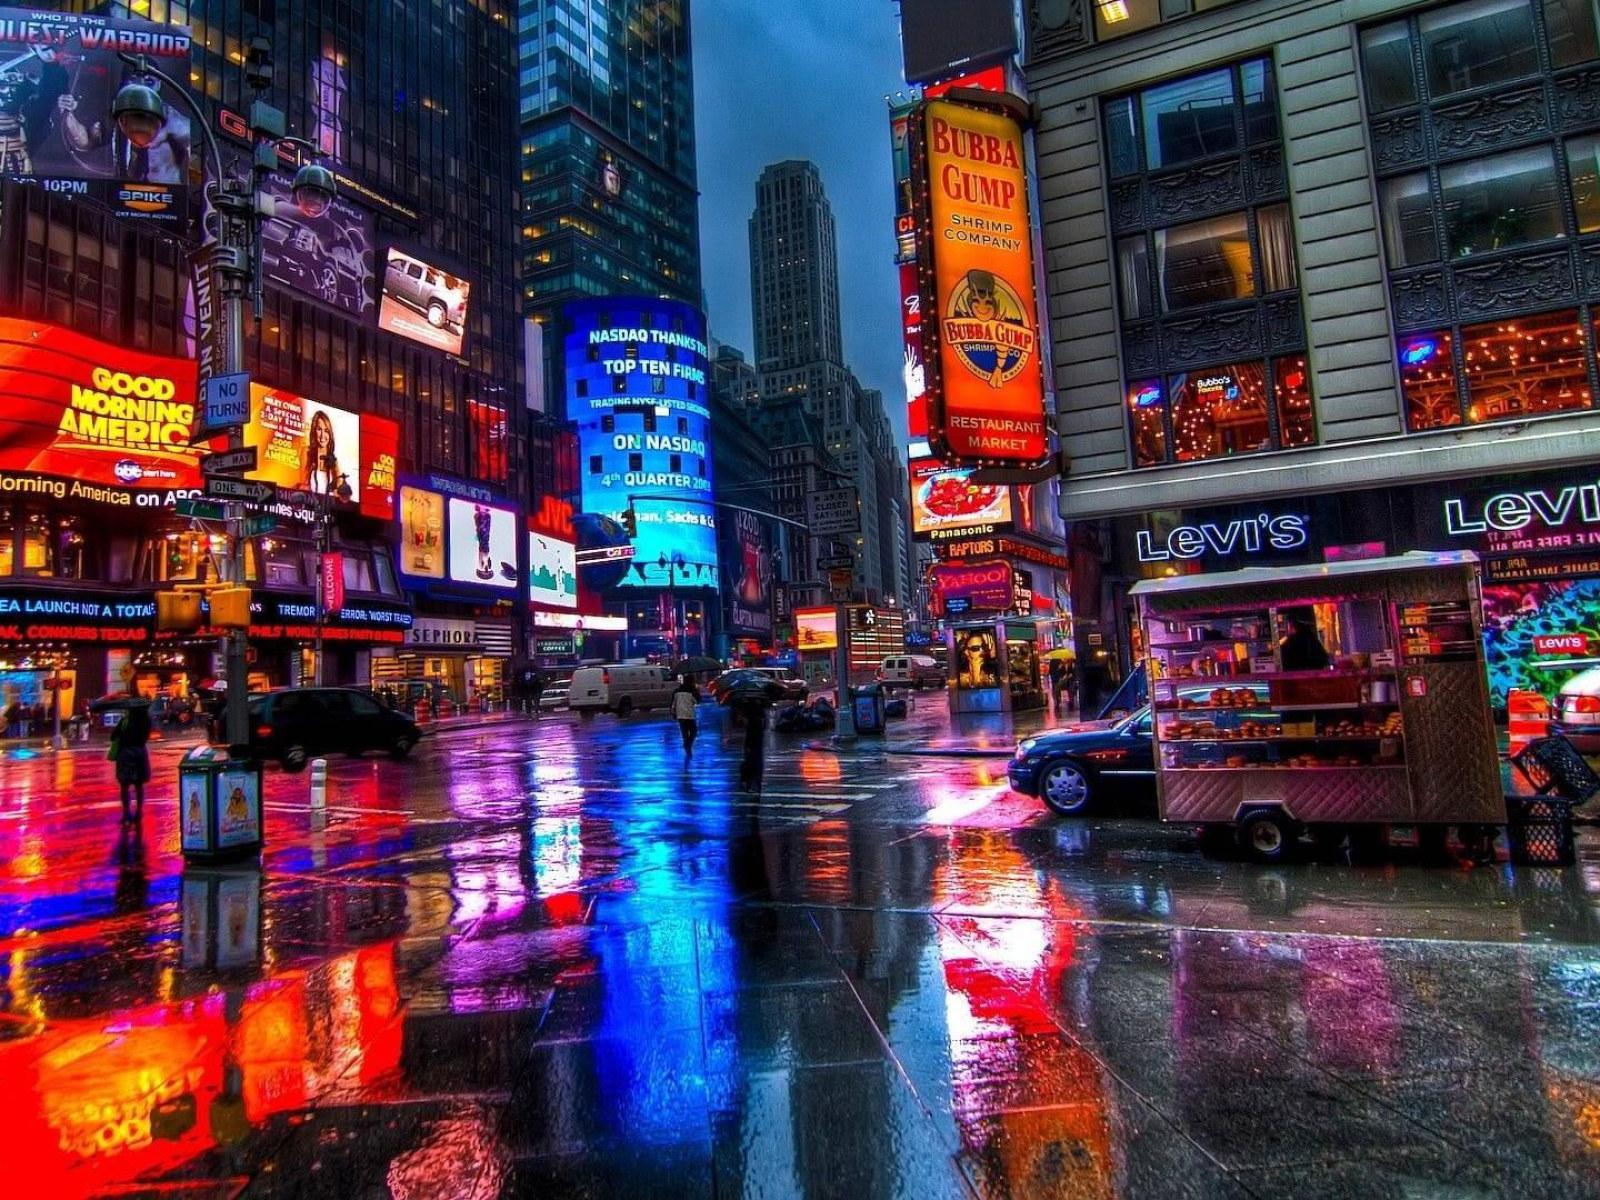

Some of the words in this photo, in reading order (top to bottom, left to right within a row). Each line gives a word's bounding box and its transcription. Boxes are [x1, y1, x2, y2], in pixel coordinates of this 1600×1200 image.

[31, 12, 62, 23] WHO
[65, 15, 77, 23] IS
[80, 17, 105, 26] THE
[79, 28, 190, 58] WARRIOR
[931, 116, 1020, 169] BUBBA
[43, 179, 88, 194] 10PM
[942, 163, 1015, 209] GUMP
[120, 190, 173, 203] SPIKE
[952, 214, 1013, 233] SHRIMP
[944, 228, 1021, 251] COMPANY
[590, 328, 648, 344] NASDAQ
[650, 330, 696, 350] THANKS
[946, 320, 993, 342] BUBBA
[995, 322, 1032, 350] GUMP
[963, 343, 995, 352] SHRIMP
[603, 360, 636, 375] TOP
[639, 360, 670, 376] TEN
[673, 363, 705, 385] FIRMS
[92, 367, 176, 401] GOOD
[218, 382, 238, 397] NO
[71, 384, 194, 425] MORNING
[210, 401, 248, 418] TURNS
[58, 407, 191, 448] AMERIC
[951, 415, 1041, 433] RESTAURANT
[613, 434, 641, 450] ON
[646, 435, 705, 458] NASDAQ
[968, 435, 1028, 450] MARKET
[232, 452, 251, 464] WAY
[115, 463, 142, 480] abc
[601, 473, 621, 487] 4th
[624, 472, 690, 488] QUARTER
[0, 474, 66, 497] orning
[71, 480, 131, 506] America
[136, 493, 160, 507] on
[214, 481, 236, 493] ONE
[244, 485, 266, 498] WAY
[187, 500, 197, 515] 7
[541, 495, 574, 535] JVC
[930, 525, 994, 539] Panasonic
[949, 540, 994, 557] RAPTORS
[325, 558, 335, 612] WELCOME
[937, 567, 1006, 589] YAHOO!
[25, 600, 80, 614] LAUNCH
[82, 603, 100, 615] NOT
[102, 605, 112, 617] A
[278, 603, 316, 617] TREMOR
[28, 626, 98, 640] CONQUERS
[100, 627, 146, 640] TEXAS
[412, 628, 479, 644] SEPHORA
